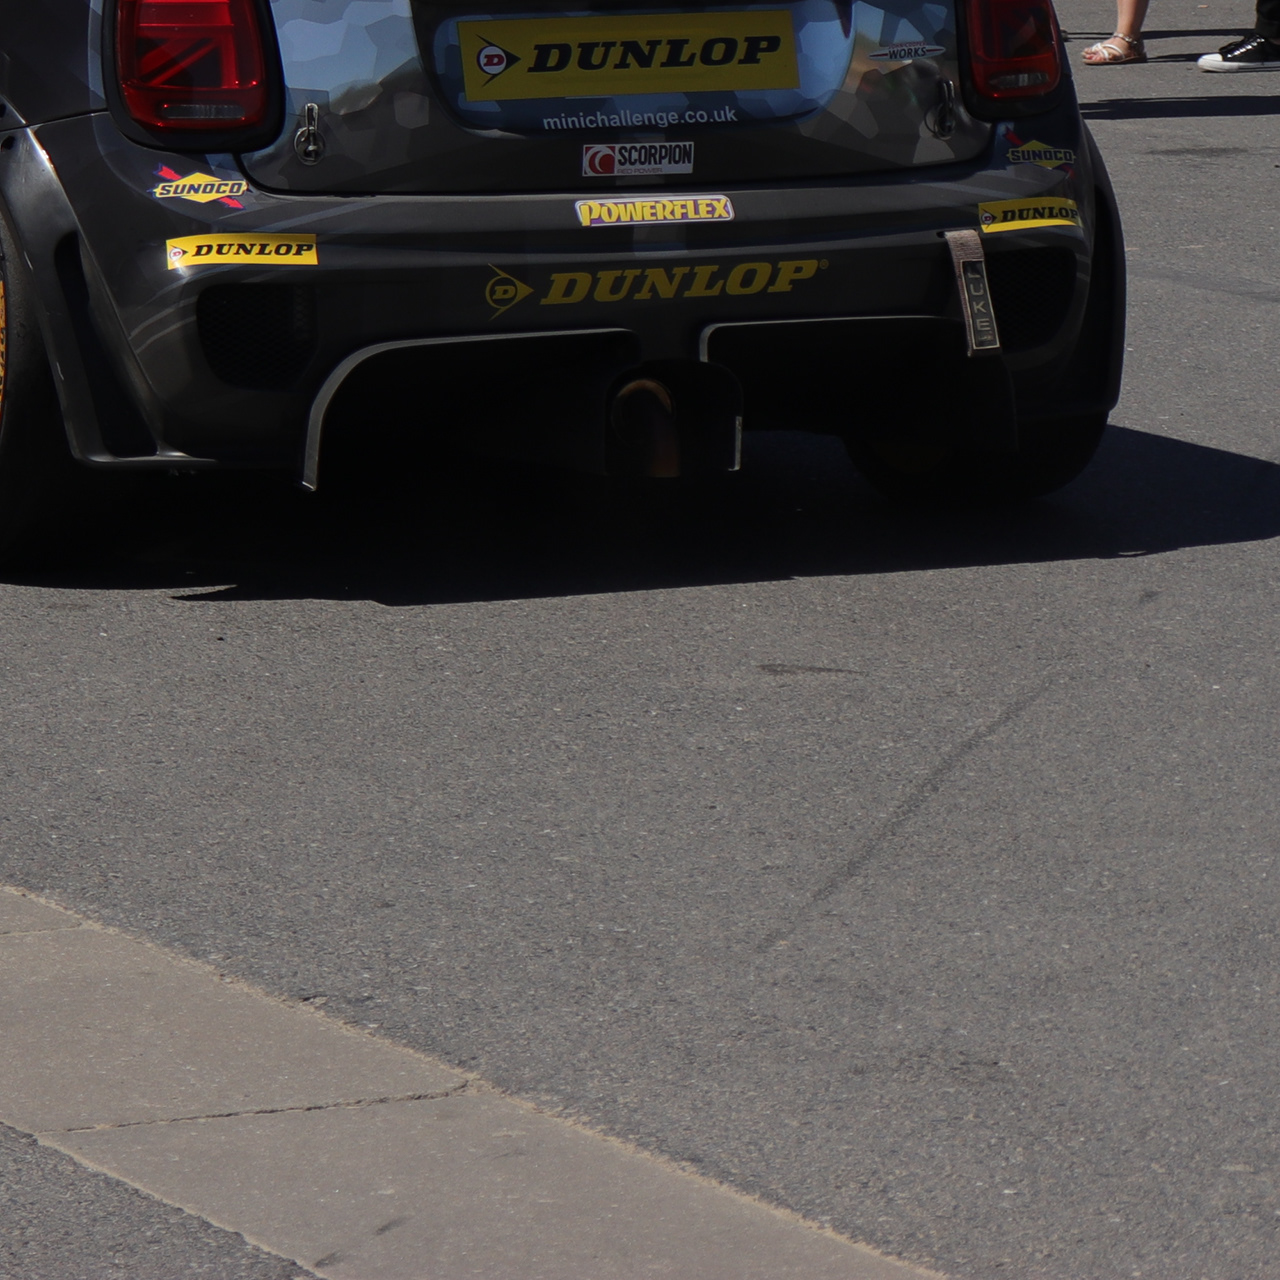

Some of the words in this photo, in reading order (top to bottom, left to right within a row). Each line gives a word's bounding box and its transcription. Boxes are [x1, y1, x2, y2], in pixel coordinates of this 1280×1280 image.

[527, 35, 781, 73] DUNLOP
[888, 47, 926, 60] WORKS
[543, 106, 738, 130] minichallenge.co.uk
[618, 144, 691, 165] SCORPION
[1011, 150, 1073, 162] SUNOCO
[159, 182, 244, 196] SUNOCO
[581, 198, 730, 226] POWERFLEX
[1002, 206, 1080, 220] DUNLOP
[192, 243, 313, 257] DUNLOP
[540, 260, 818, 305] DUNLOP
